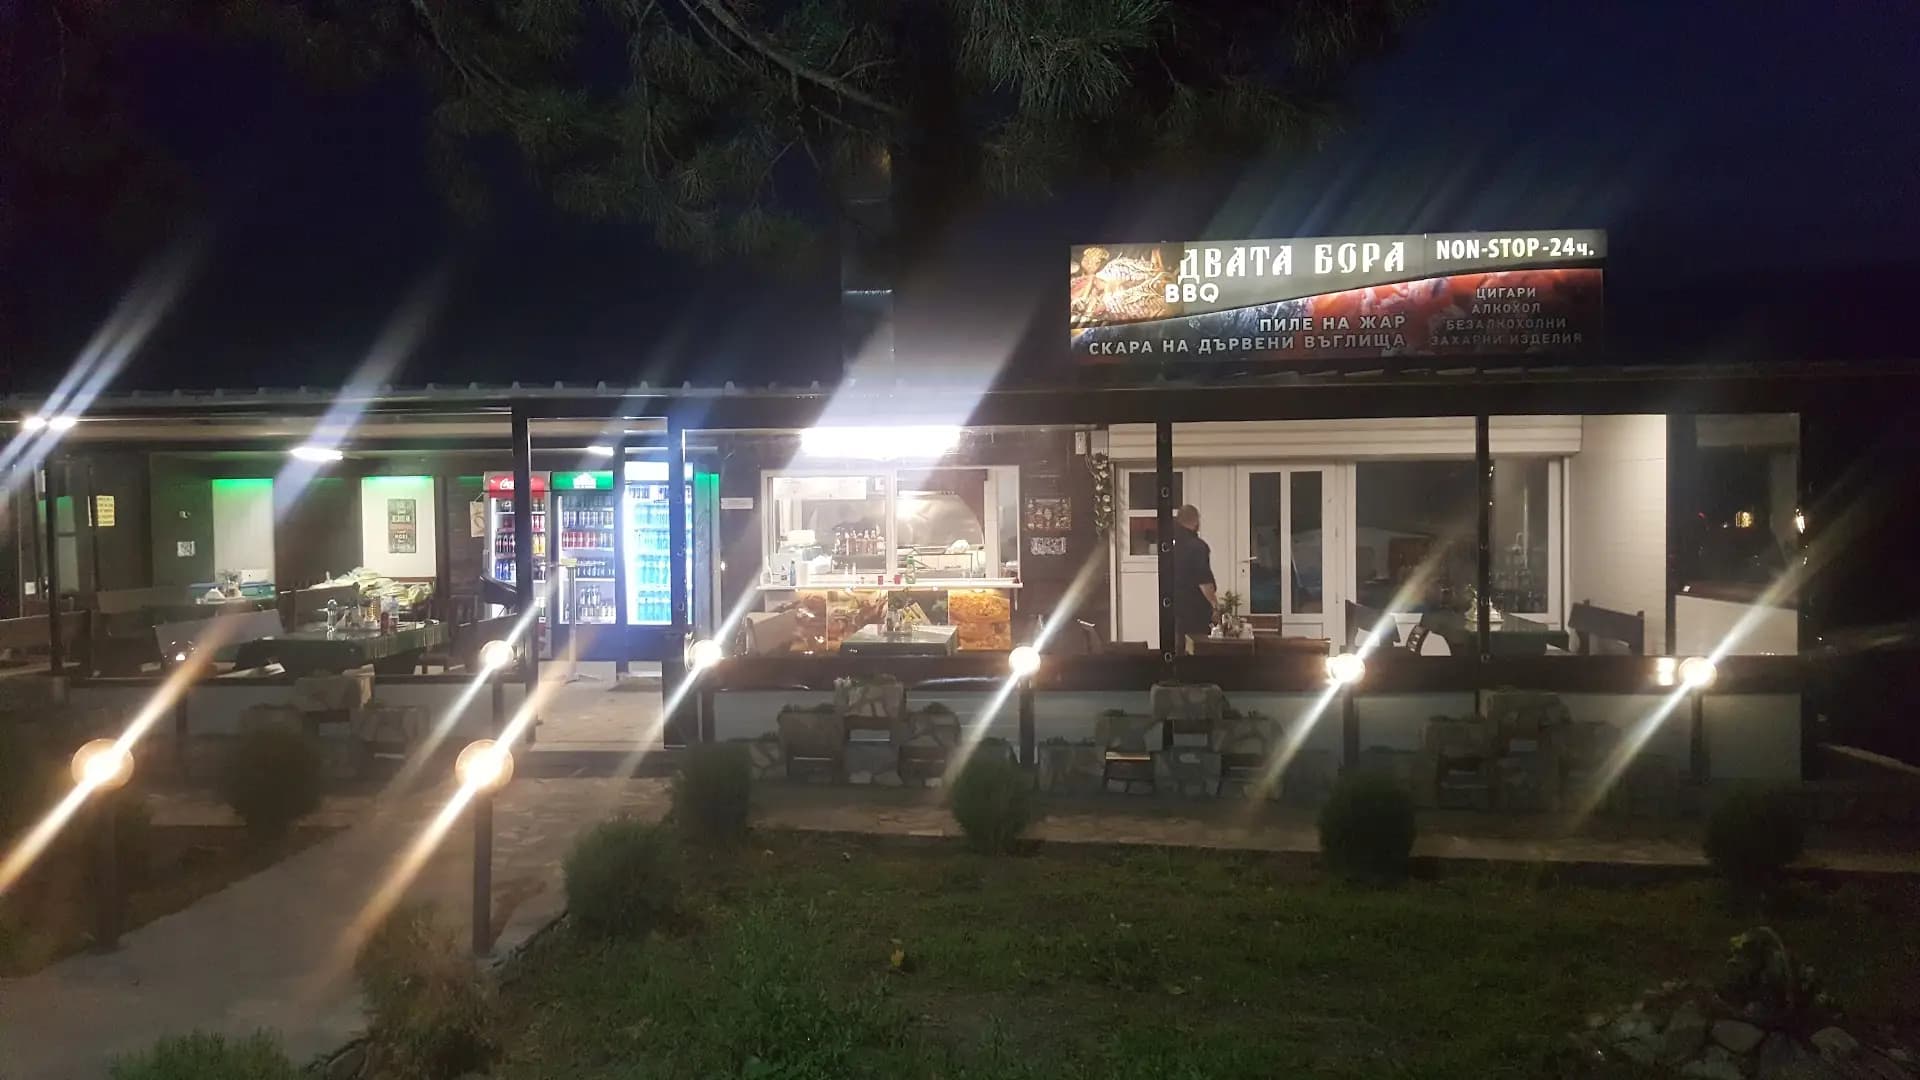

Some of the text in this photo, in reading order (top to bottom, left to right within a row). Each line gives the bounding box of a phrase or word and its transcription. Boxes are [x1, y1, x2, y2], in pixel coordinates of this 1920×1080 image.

[1178, 242, 1405, 285] ДВАТА БОРА
[1165, 283, 1220, 303] BBQ
[1476, 287, 1536, 300] ЦИГАРИ
[1471, 303, 1541, 314] АЛКОХОЛ
[1259, 315, 1405, 332] ПИЛЕ НА ЖАР
[1446, 318, 1567, 330] БЕЗАЛКОХОЛНИ
[1089, 333, 1405, 355] СКАРА НА ДЪРВЕНИ ВЪГЛИЩА
[1431, 333, 1582, 346] ЗАХАРНИ ИЗДЕЛИЯ
